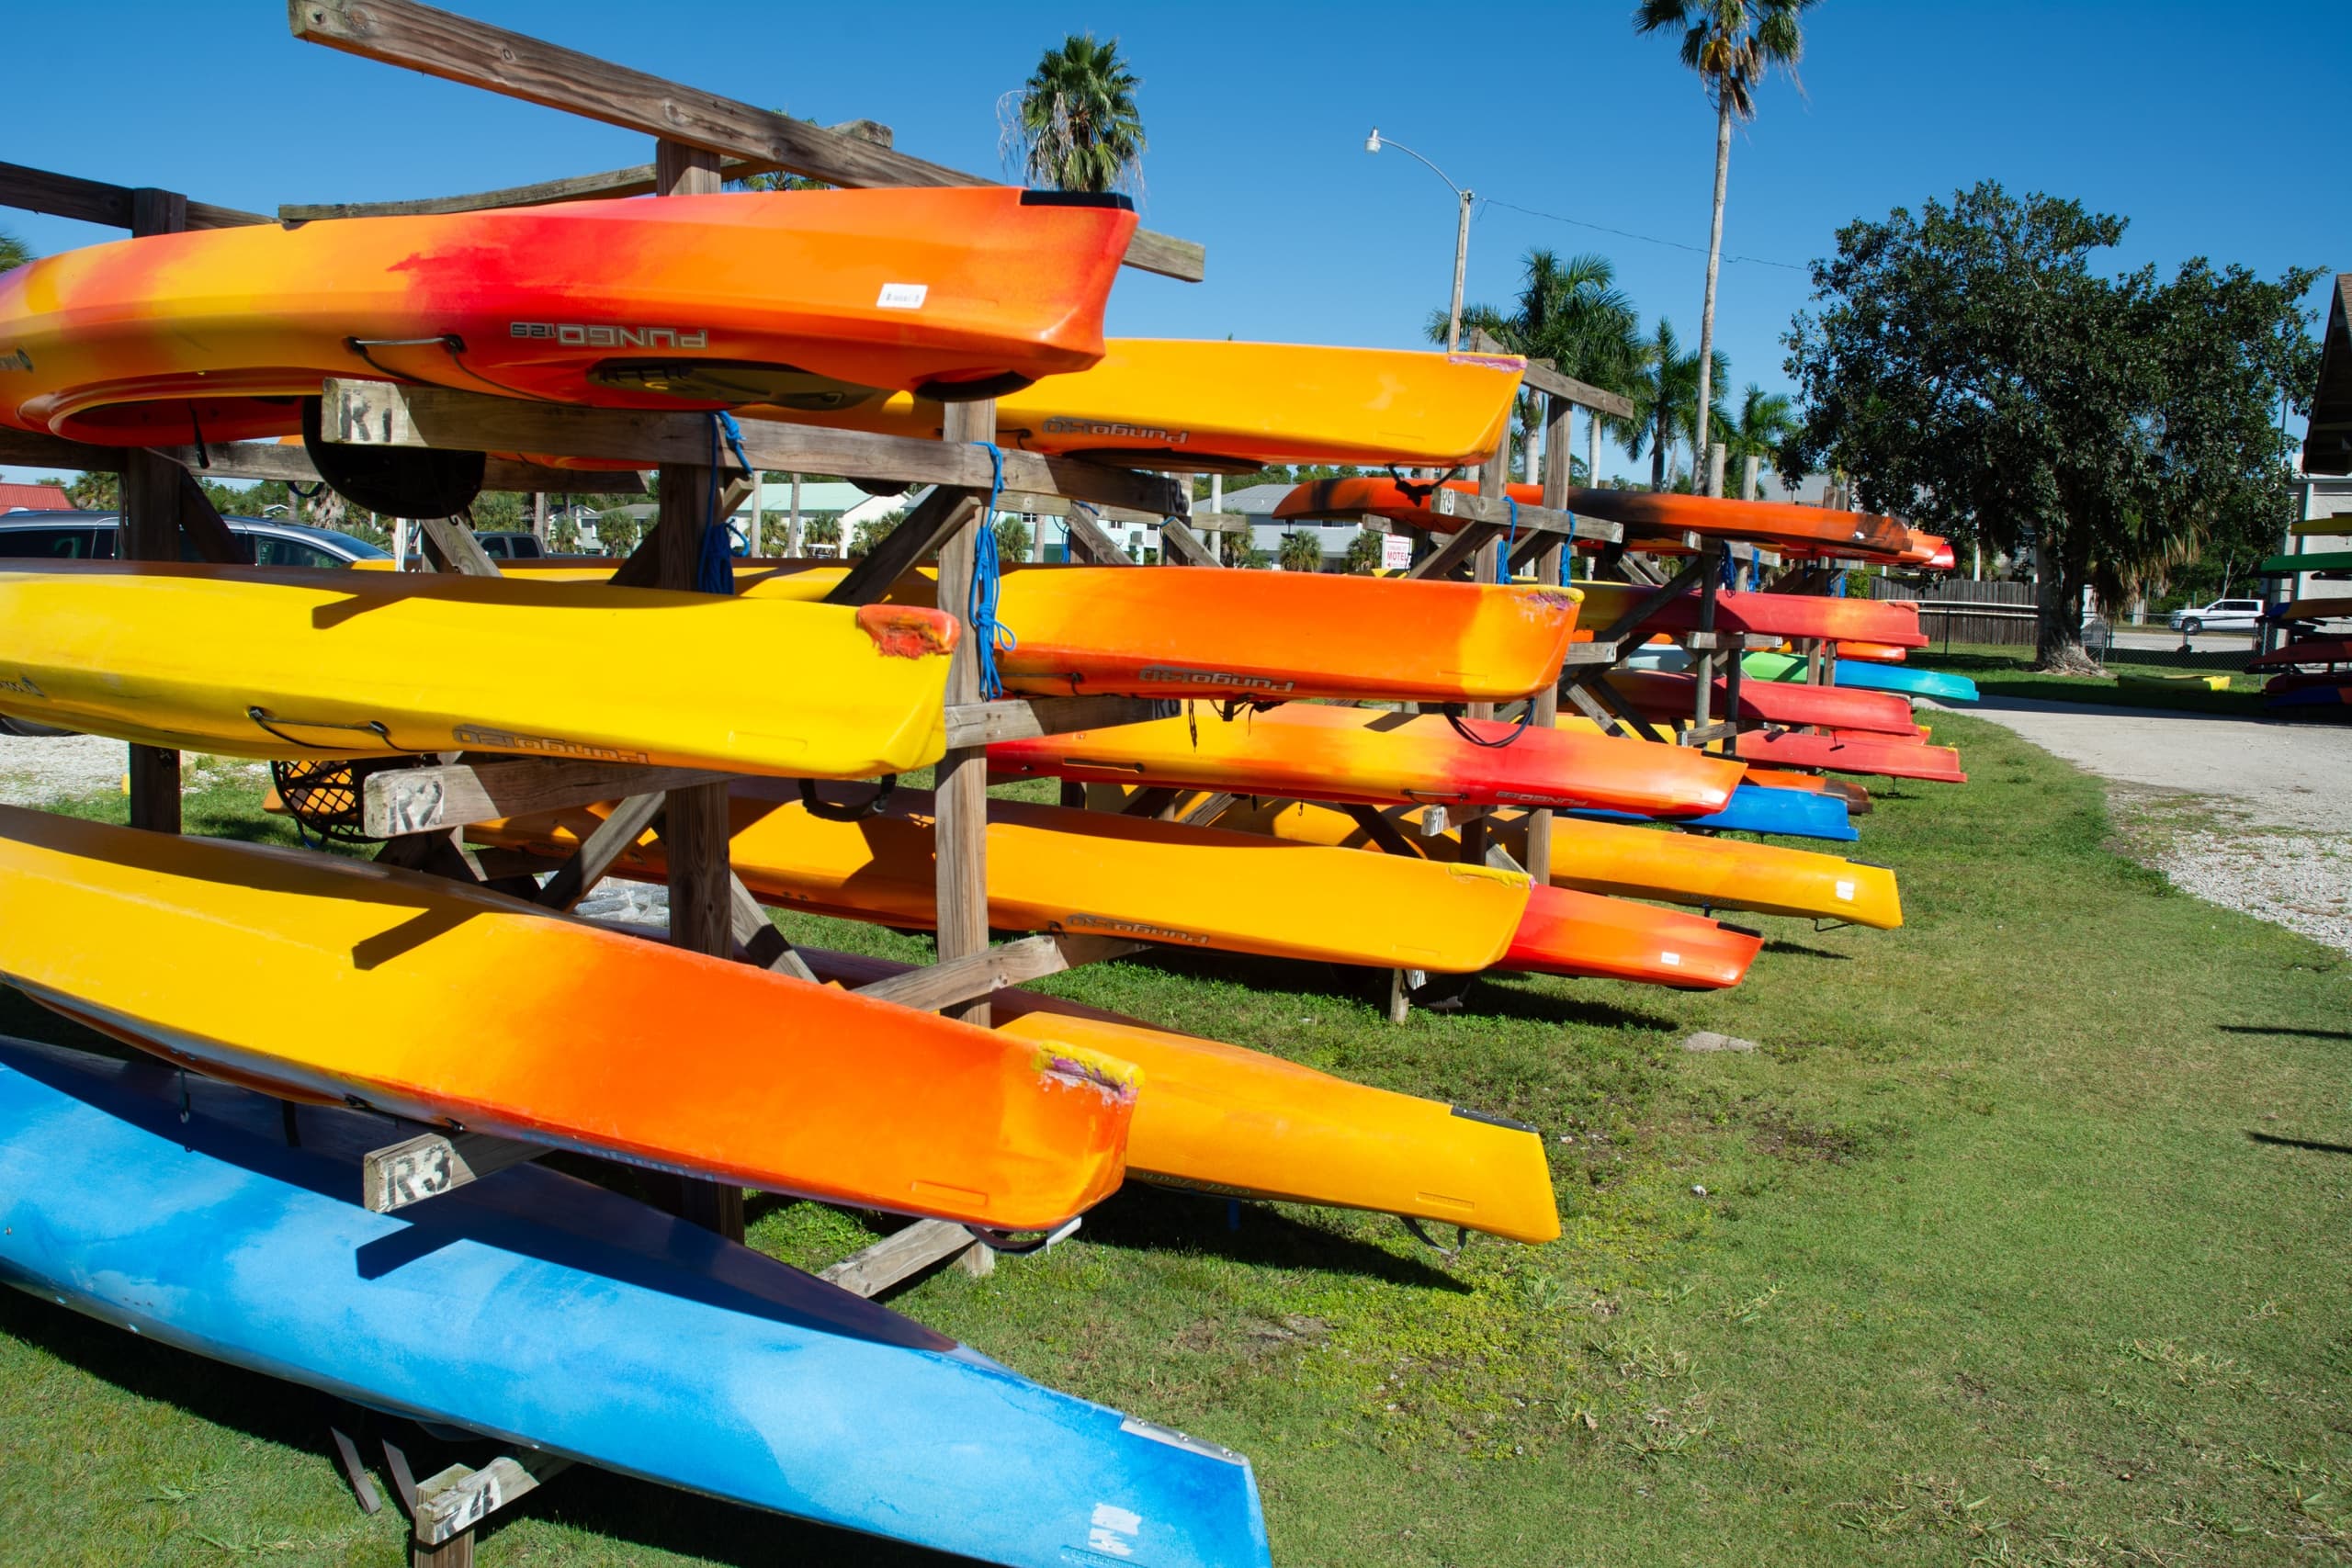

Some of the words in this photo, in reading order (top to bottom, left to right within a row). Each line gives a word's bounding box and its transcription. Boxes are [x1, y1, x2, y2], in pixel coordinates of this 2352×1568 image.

[340, 389, 393, 442] R1
[1387, 551, 1408, 560] MOTEL
[389, 780, 443, 835] R2
[388, 1145, 451, 1205] R3
